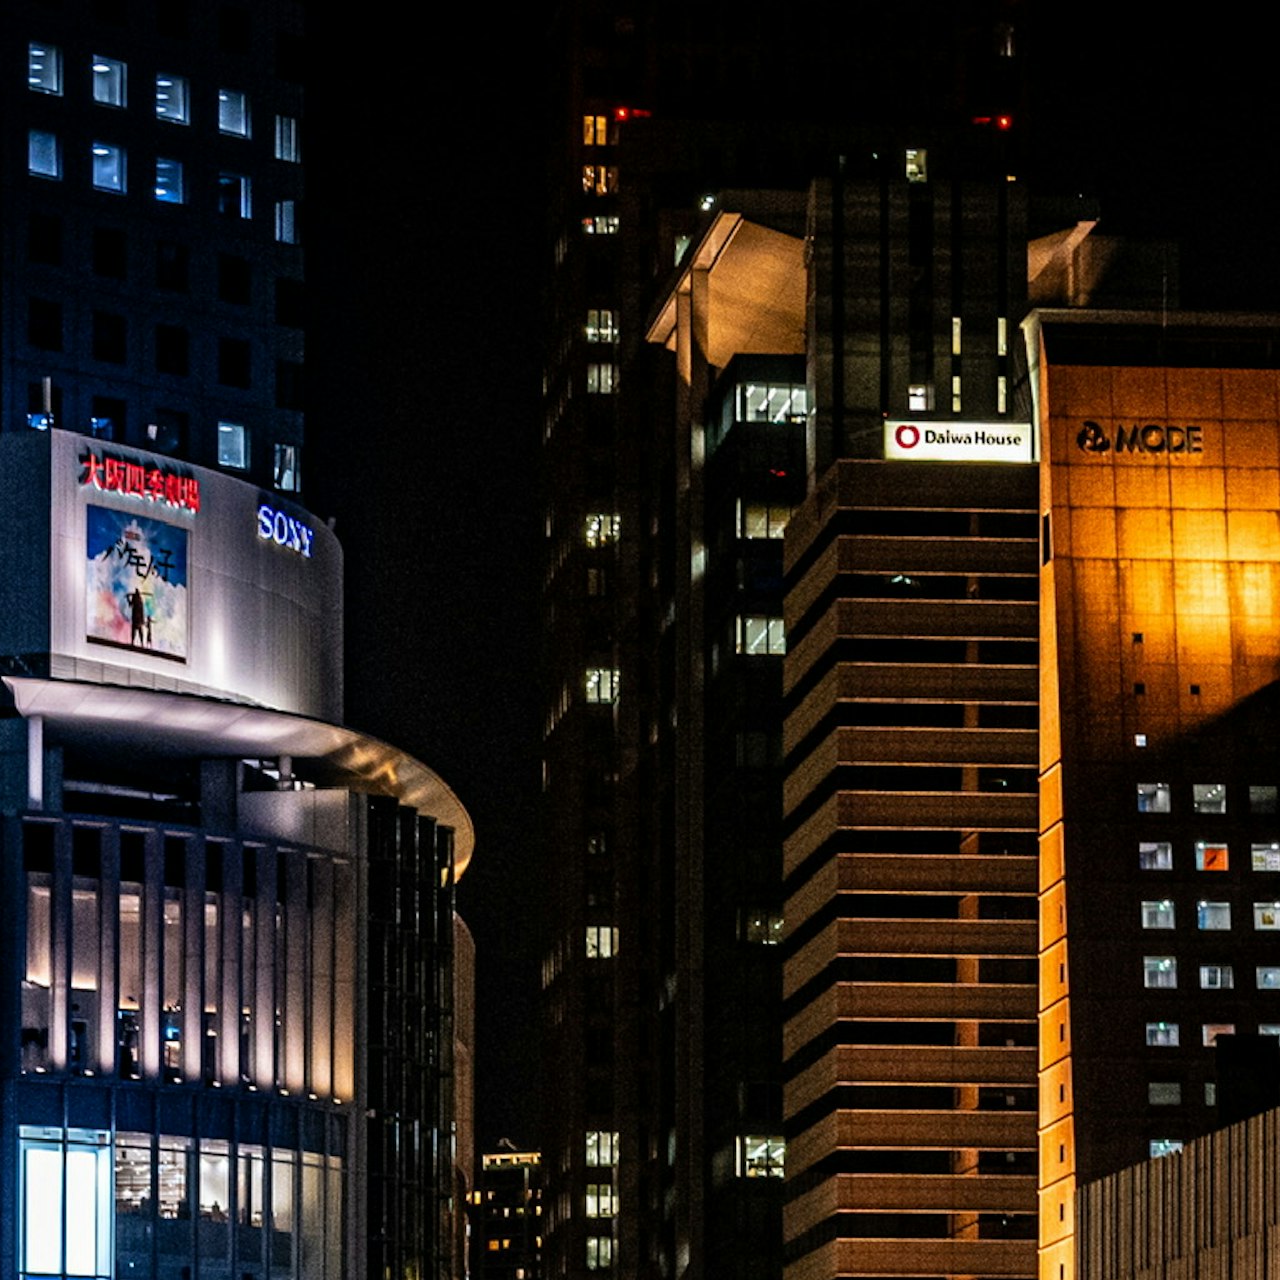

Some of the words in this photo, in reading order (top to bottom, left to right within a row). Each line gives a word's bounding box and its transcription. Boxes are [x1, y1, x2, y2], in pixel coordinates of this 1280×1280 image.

[924, 429, 971, 446] Daiwa
[975, 430, 1022, 446] House
[1114, 425, 1203, 454] MODE
[81, 453, 201, 513] 大阪四季劇場
[257, 504, 315, 558] SONY
[104, 537, 177, 582] バケモノの子
